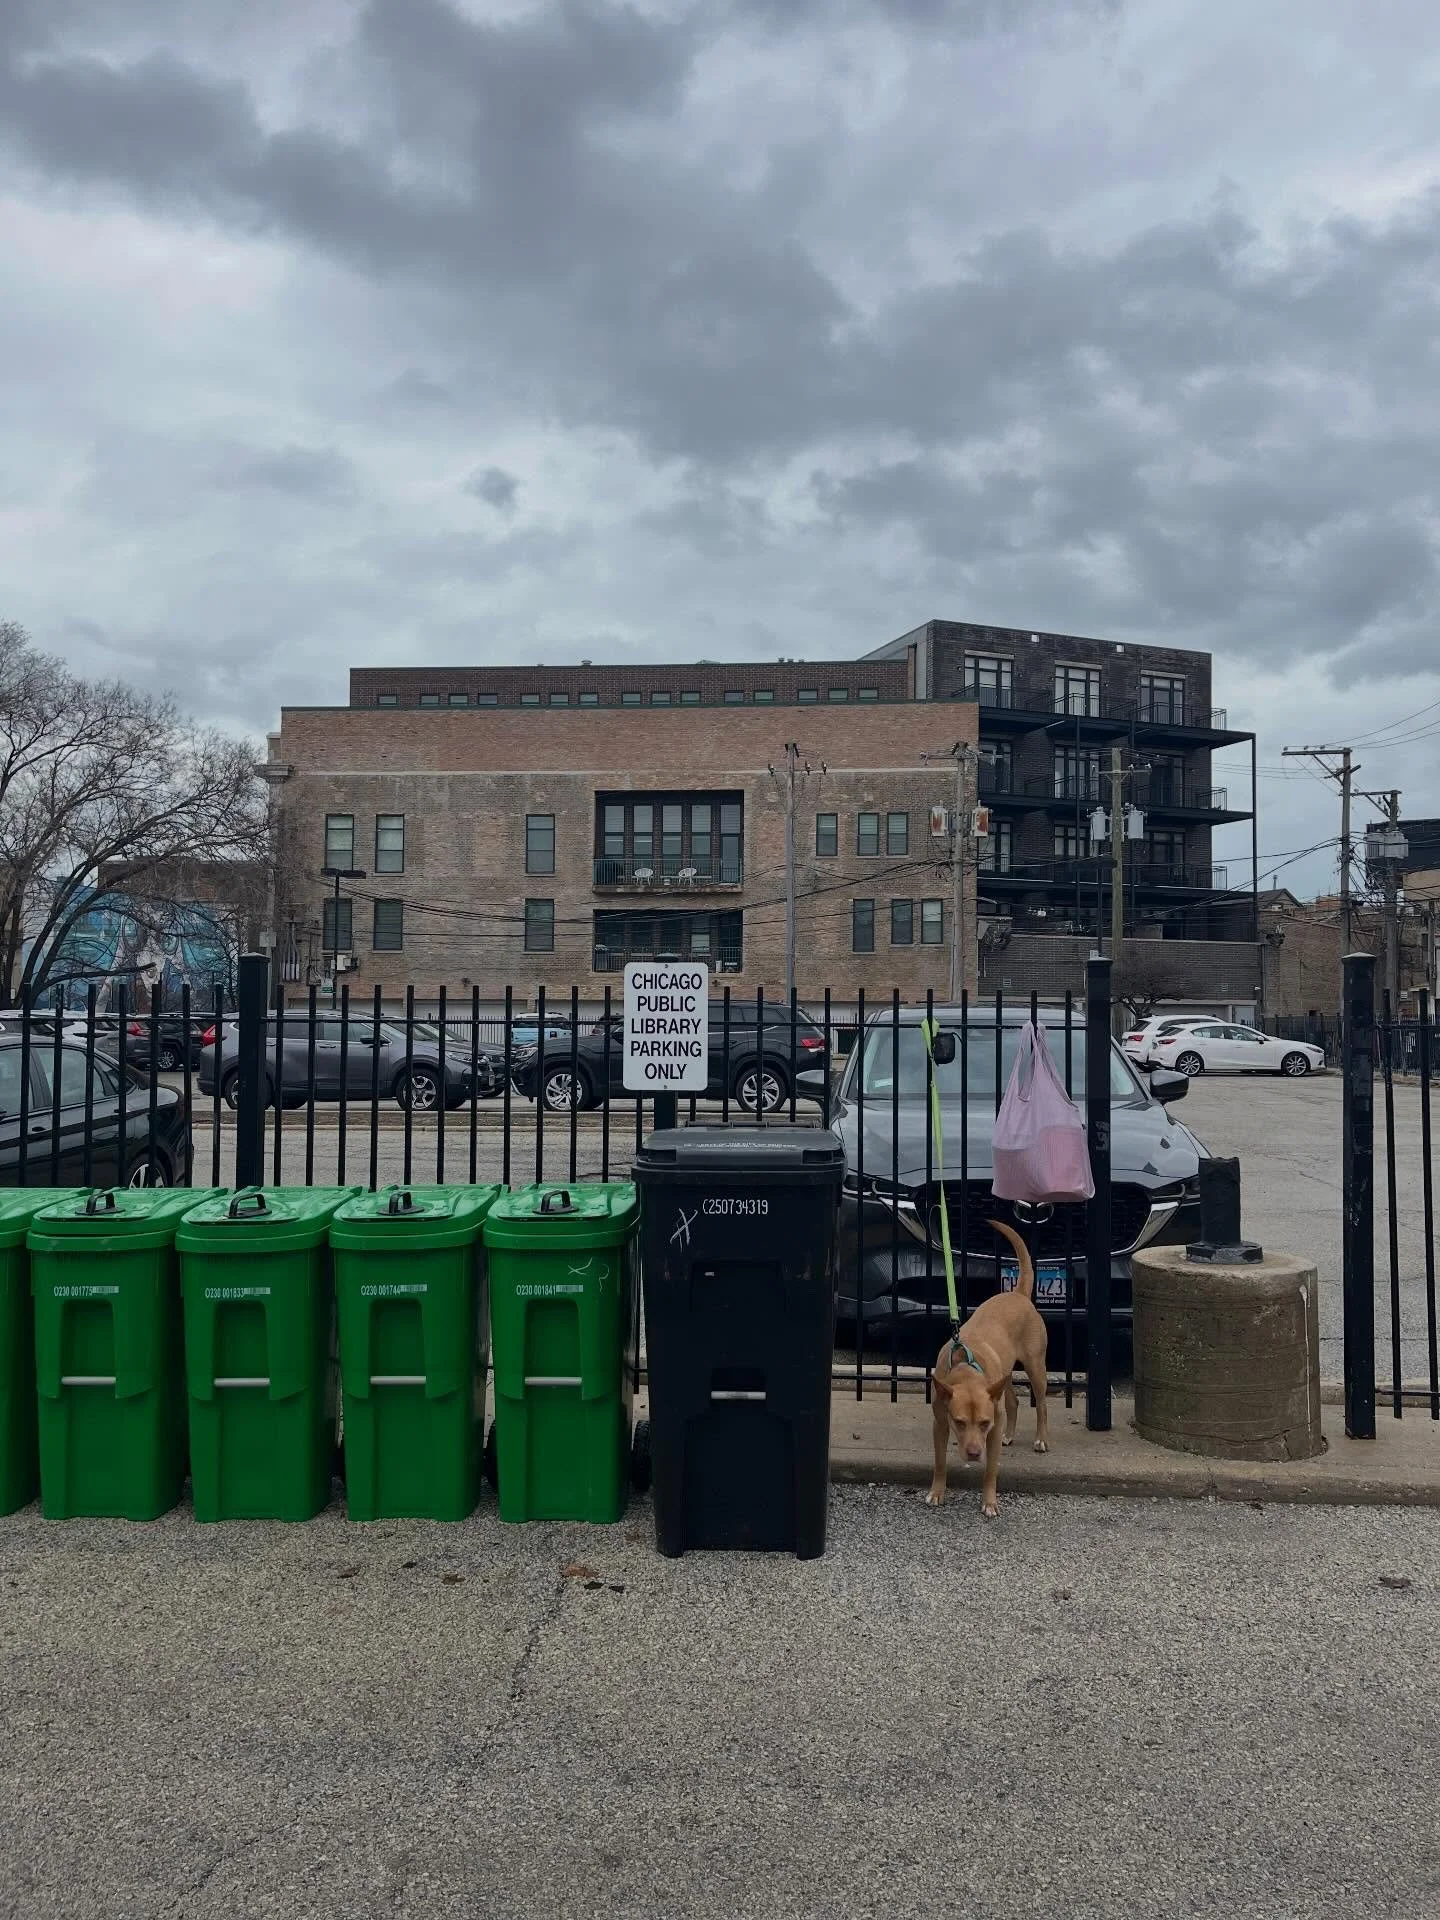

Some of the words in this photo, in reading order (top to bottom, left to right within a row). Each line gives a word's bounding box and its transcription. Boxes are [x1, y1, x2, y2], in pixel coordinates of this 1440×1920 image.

[631, 973, 703, 990] CHICAGO
[637, 995, 696, 1012] PUBLIC
[631, 1018, 701, 1035] LIBRARY
[630, 1040, 702, 1058] PARKING
[644, 1062, 687, 1080] ONLY
[702, 1198, 769, 1215] C250734319
